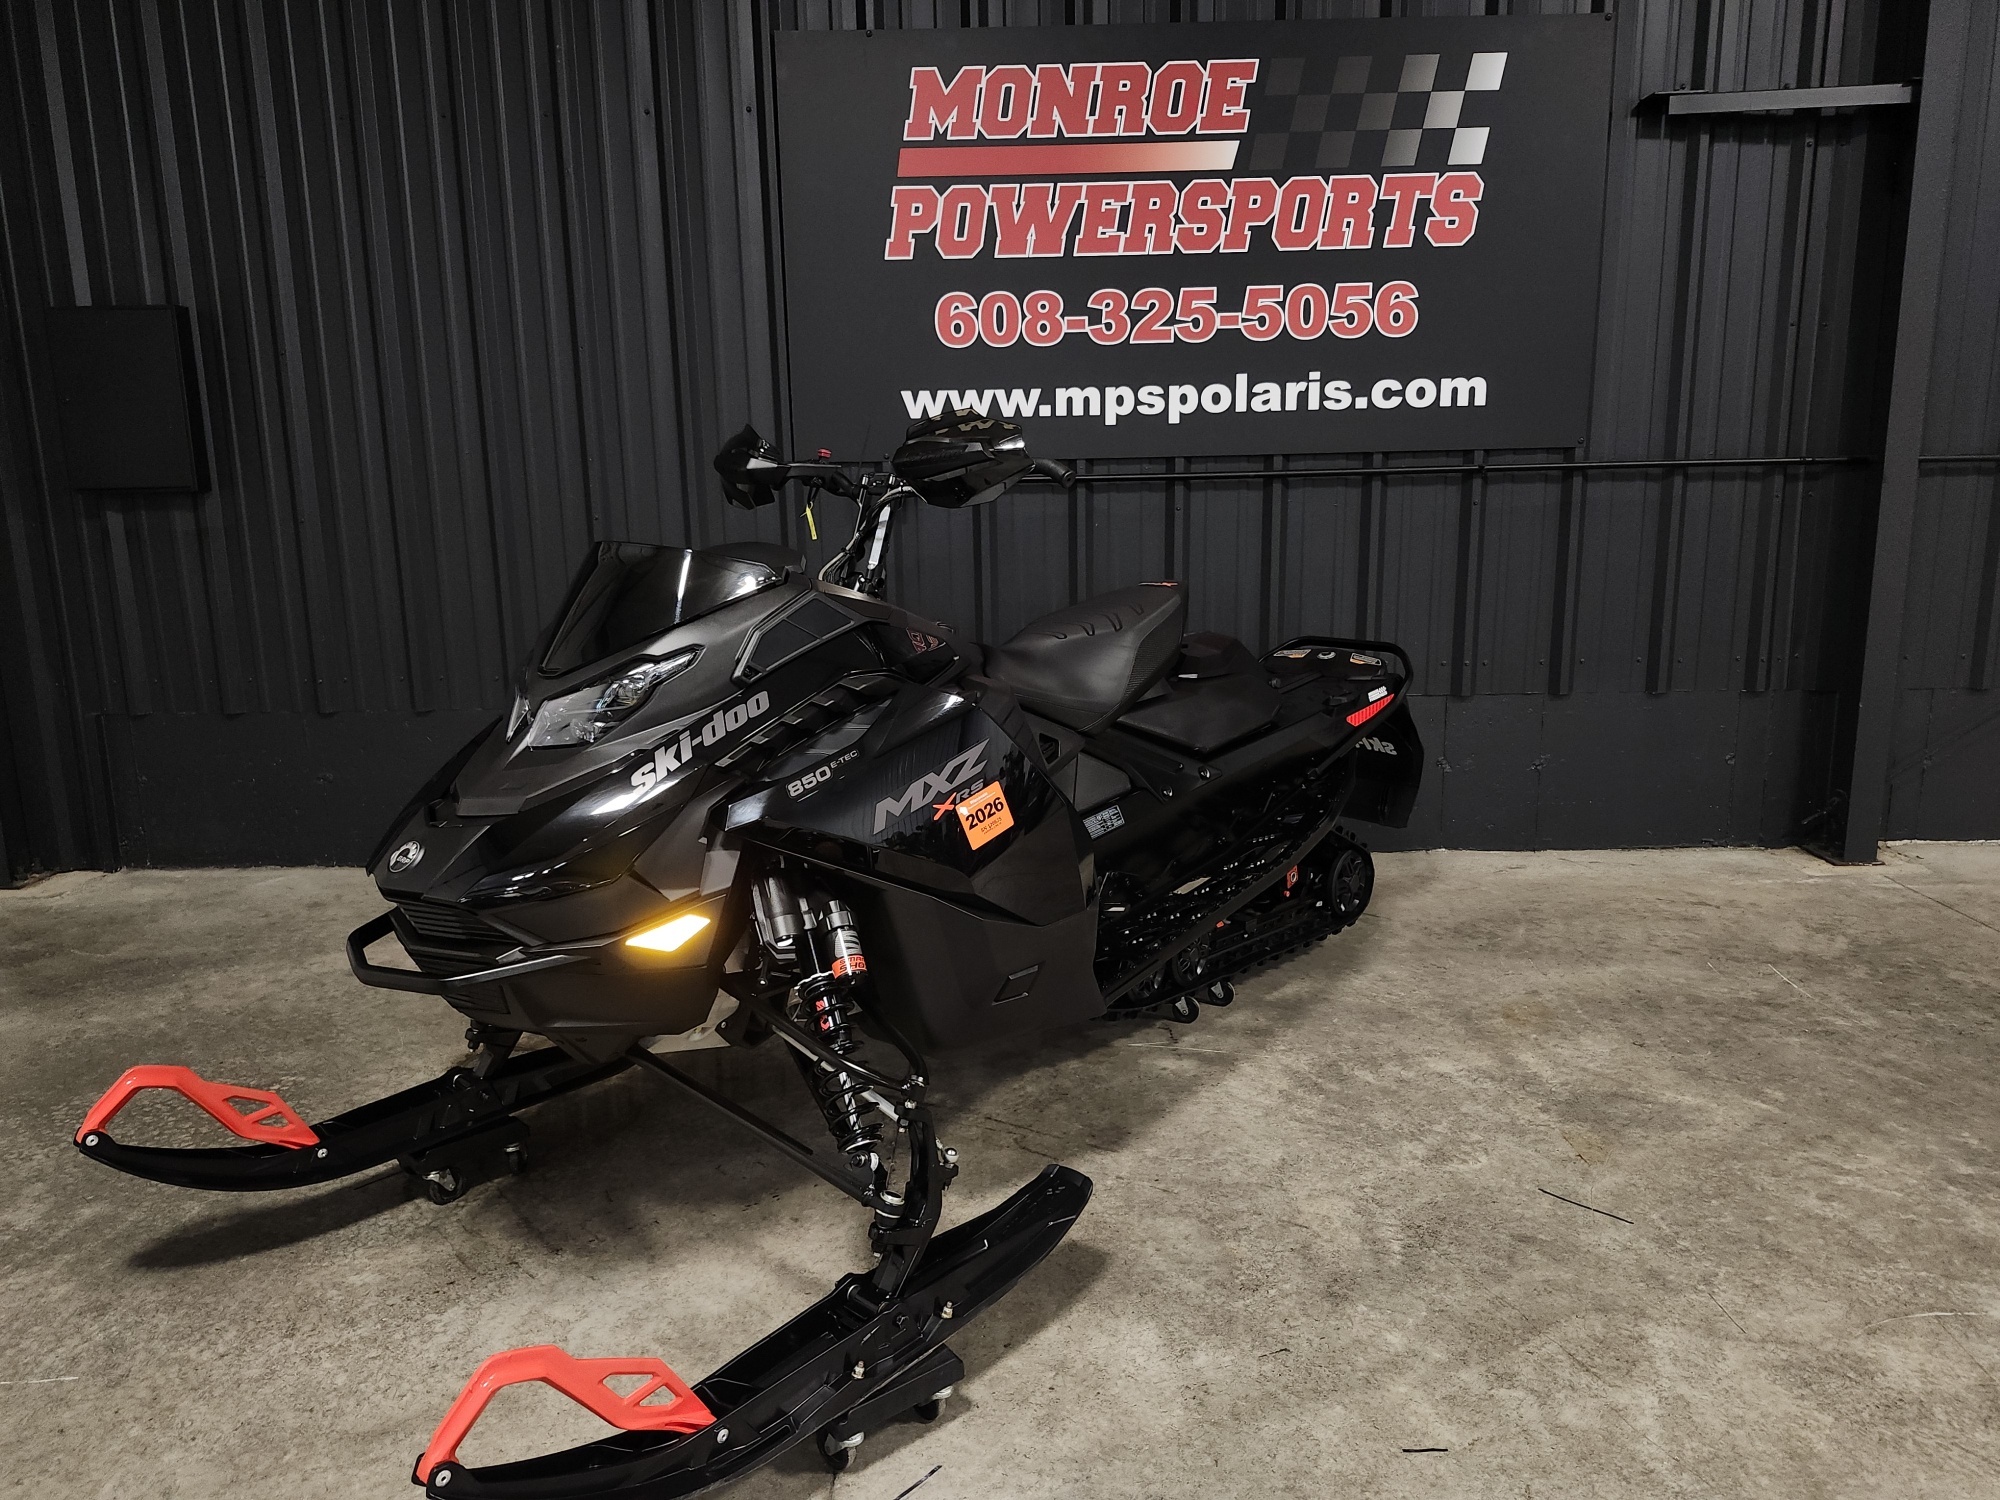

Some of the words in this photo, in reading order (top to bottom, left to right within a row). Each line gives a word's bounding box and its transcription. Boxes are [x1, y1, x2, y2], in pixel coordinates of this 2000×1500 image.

[903, 58, 1260, 141] MONROE
[884, 172, 1485, 261] POWERSPORTS
[934, 280, 1419, 348] 608-325-5056
[901, 372, 1488, 424] www.mpspolaris.com
[787, 765, 831, 797] 850
[830, 750, 858, 769] E-TEC
[873, 738, 990, 835] MXZ
[965, 796, 1004, 831] 2026
